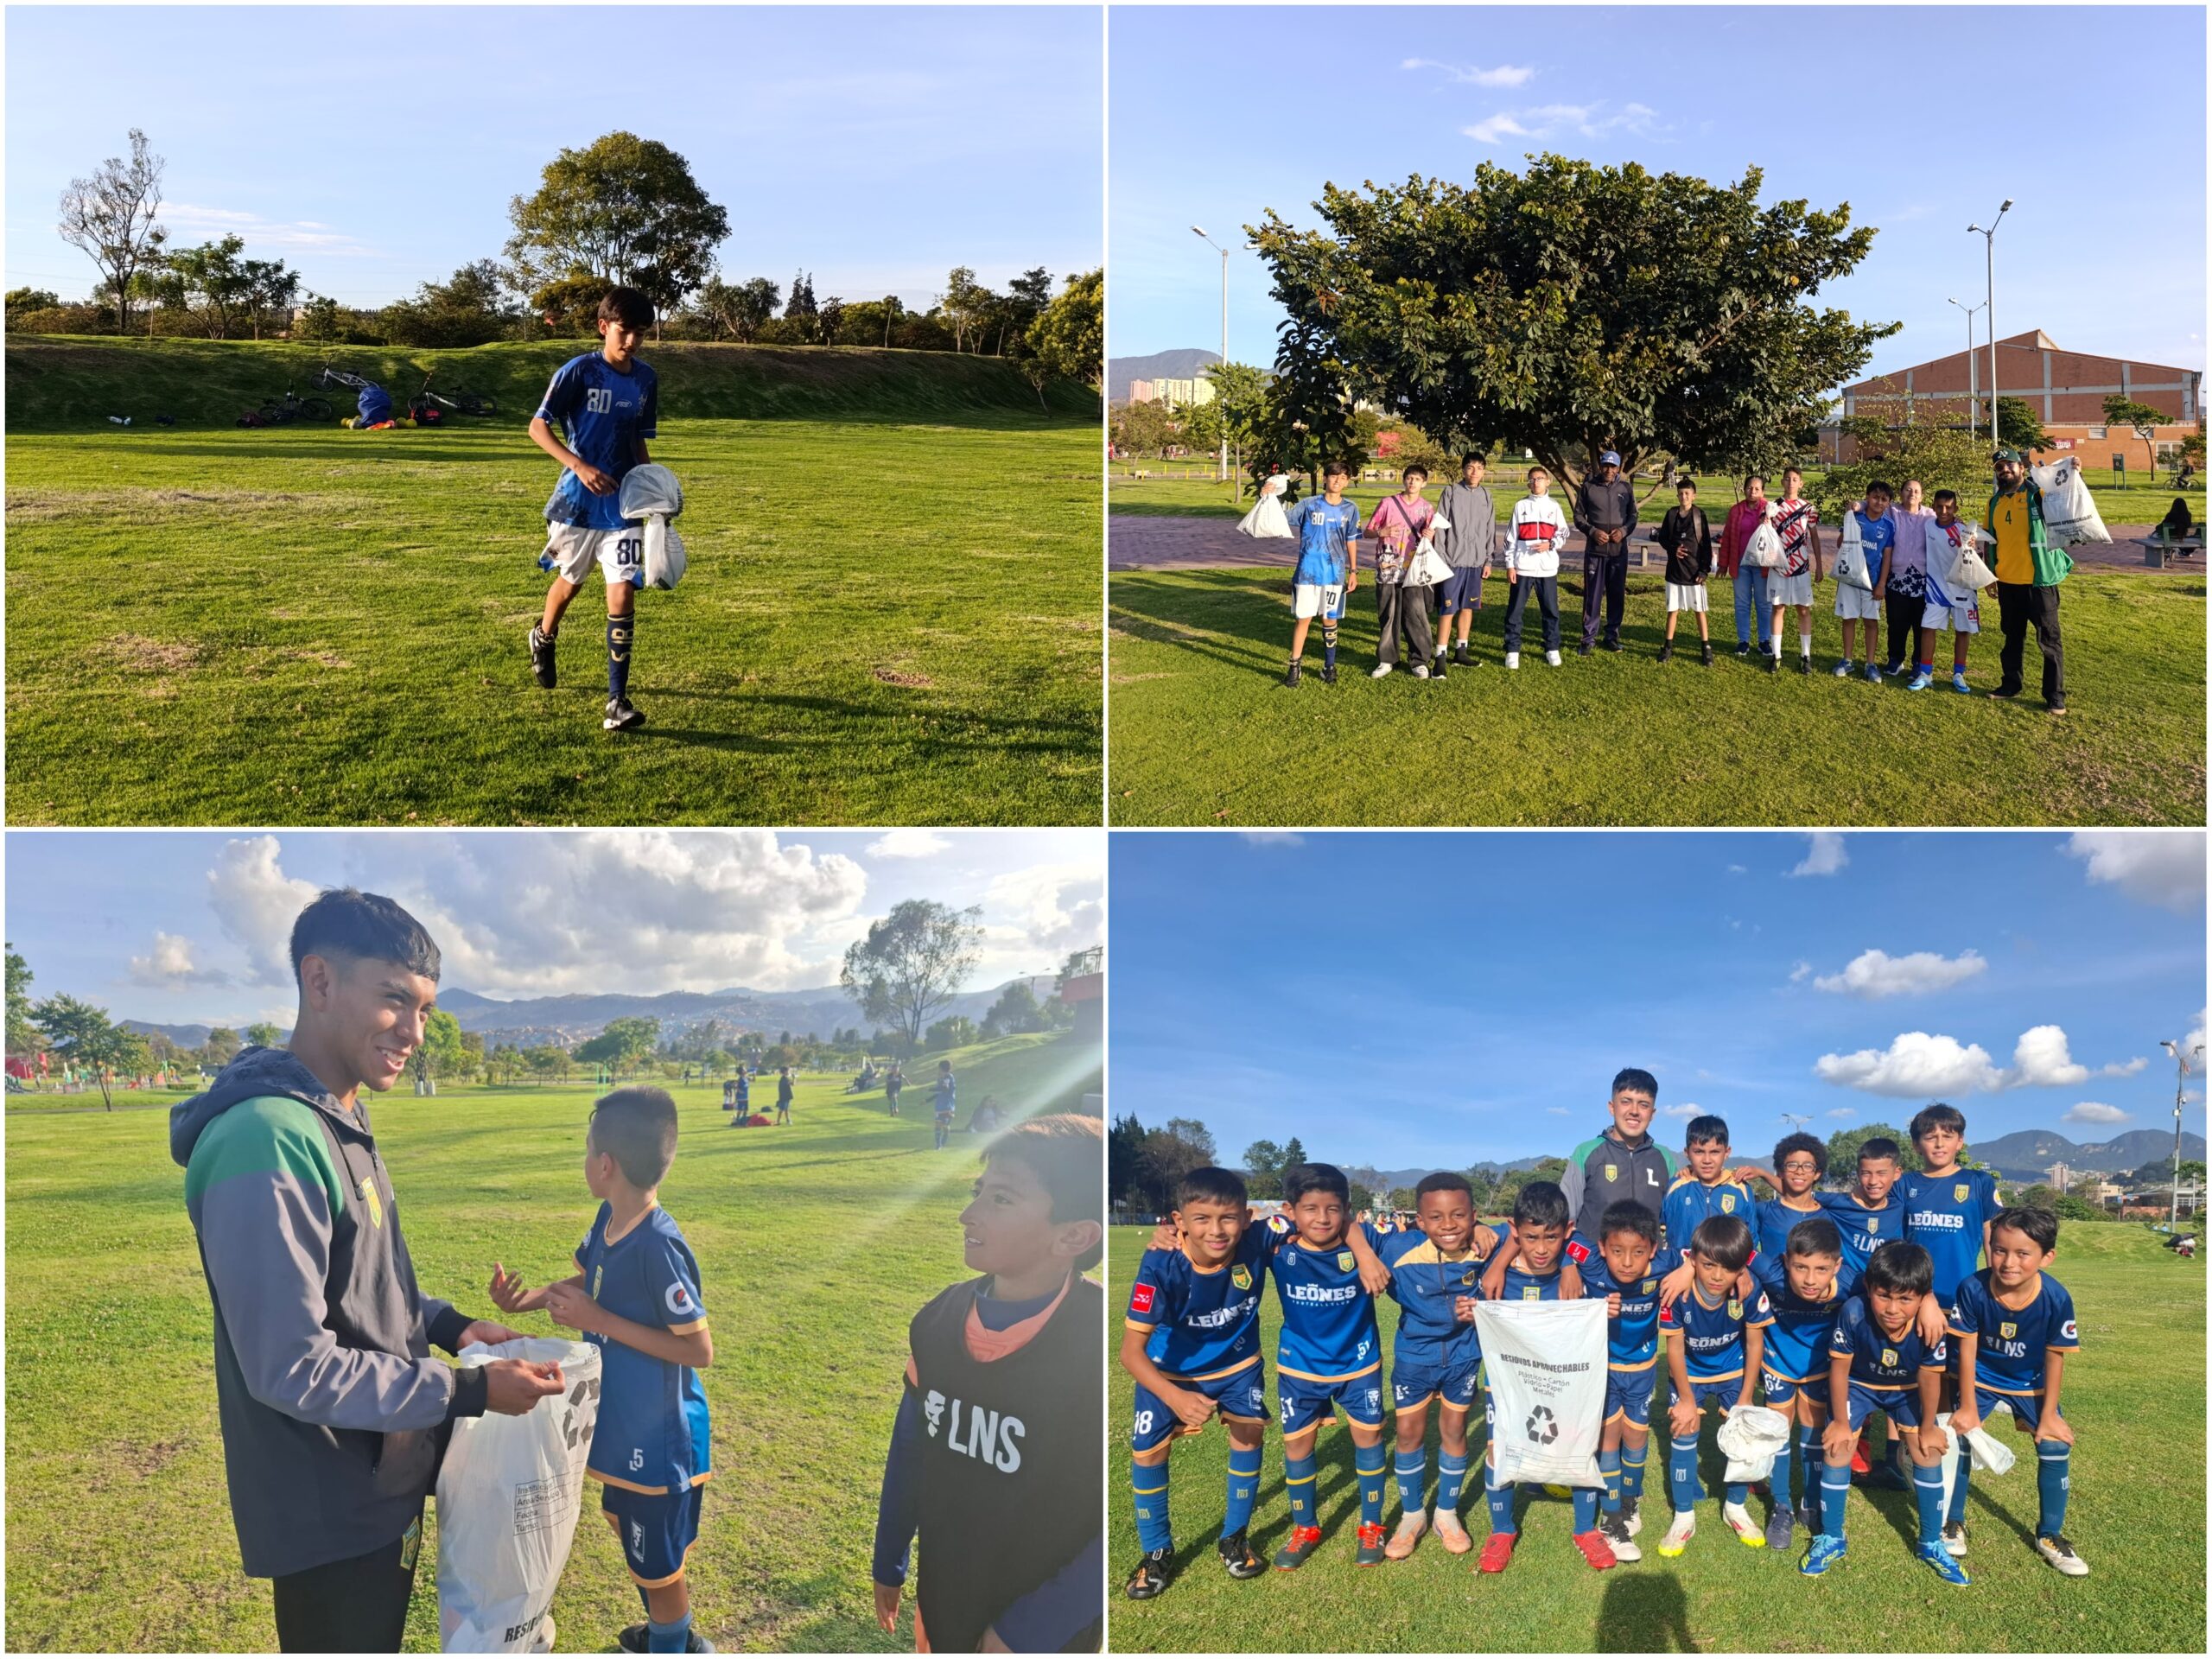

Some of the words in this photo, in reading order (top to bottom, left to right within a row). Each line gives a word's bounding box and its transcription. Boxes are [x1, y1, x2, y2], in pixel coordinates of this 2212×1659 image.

[588, 388, 612, 414] 80
[1312, 512, 1325, 525] 80
[2005, 510, 2012, 525] 4
[617, 538, 642, 565] 80
[1861, 540, 1878, 550] DINA
[1967, 609, 1978, 620] 20
[1647, 1168, 1659, 1186] L
[1621, 1302, 1654, 1313] NES
[1688, 1332, 1739, 1348] EONES
[1995, 1338, 2027, 1357] LNS
[1500, 1353, 1532, 1367] RESIDUOS
[1532, 1360, 1590, 1374] APROVECHABLES
[1877, 1366, 1908, 1376] LNS
[948, 1398, 1026, 1473] LNS
